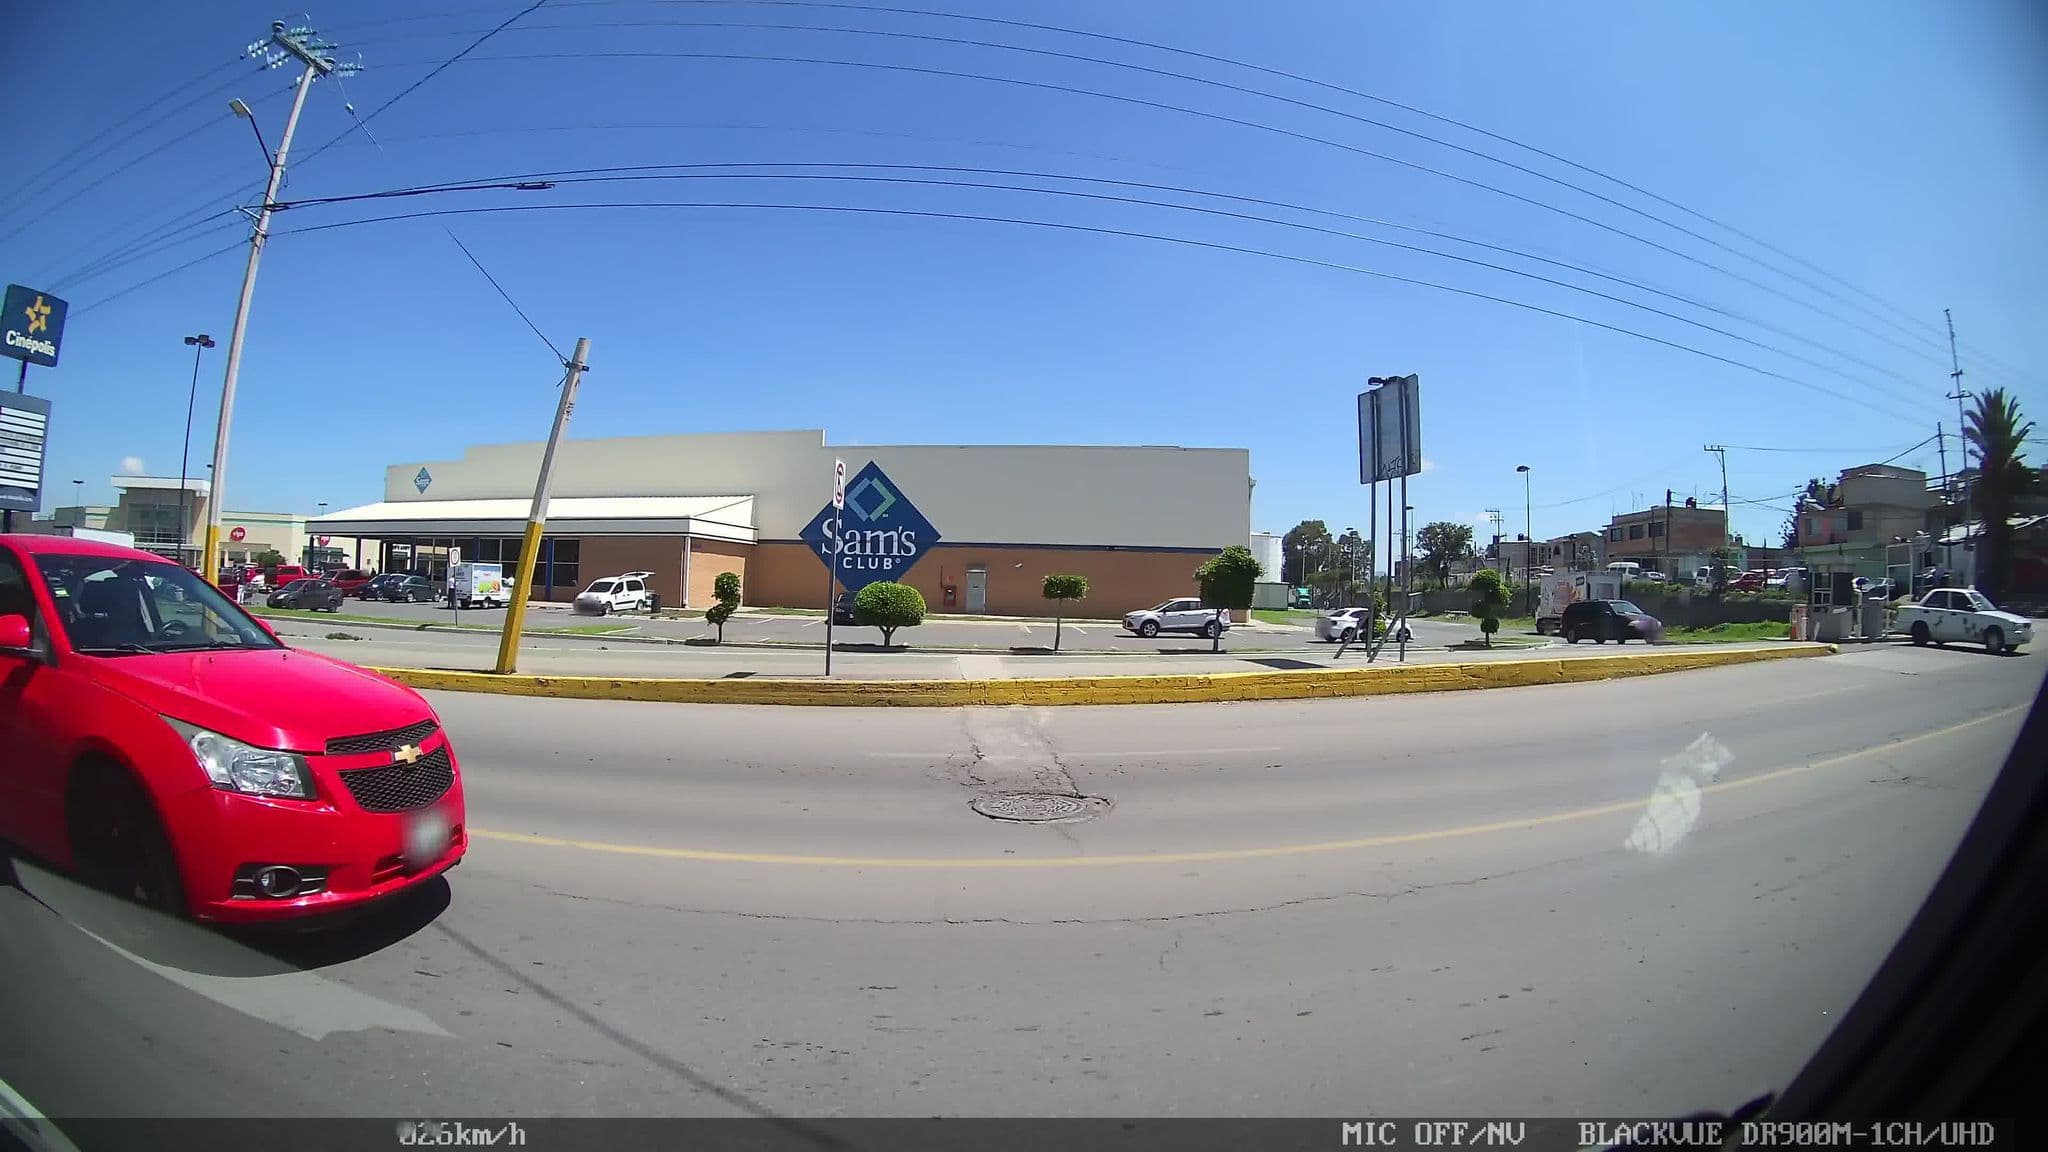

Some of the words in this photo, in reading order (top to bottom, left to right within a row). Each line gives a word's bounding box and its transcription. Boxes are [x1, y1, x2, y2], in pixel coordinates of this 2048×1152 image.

[5, 329, 56, 357] Cinépolis
[822, 518, 917, 557] Sam's
[843, 556, 893, 570] CLUB
